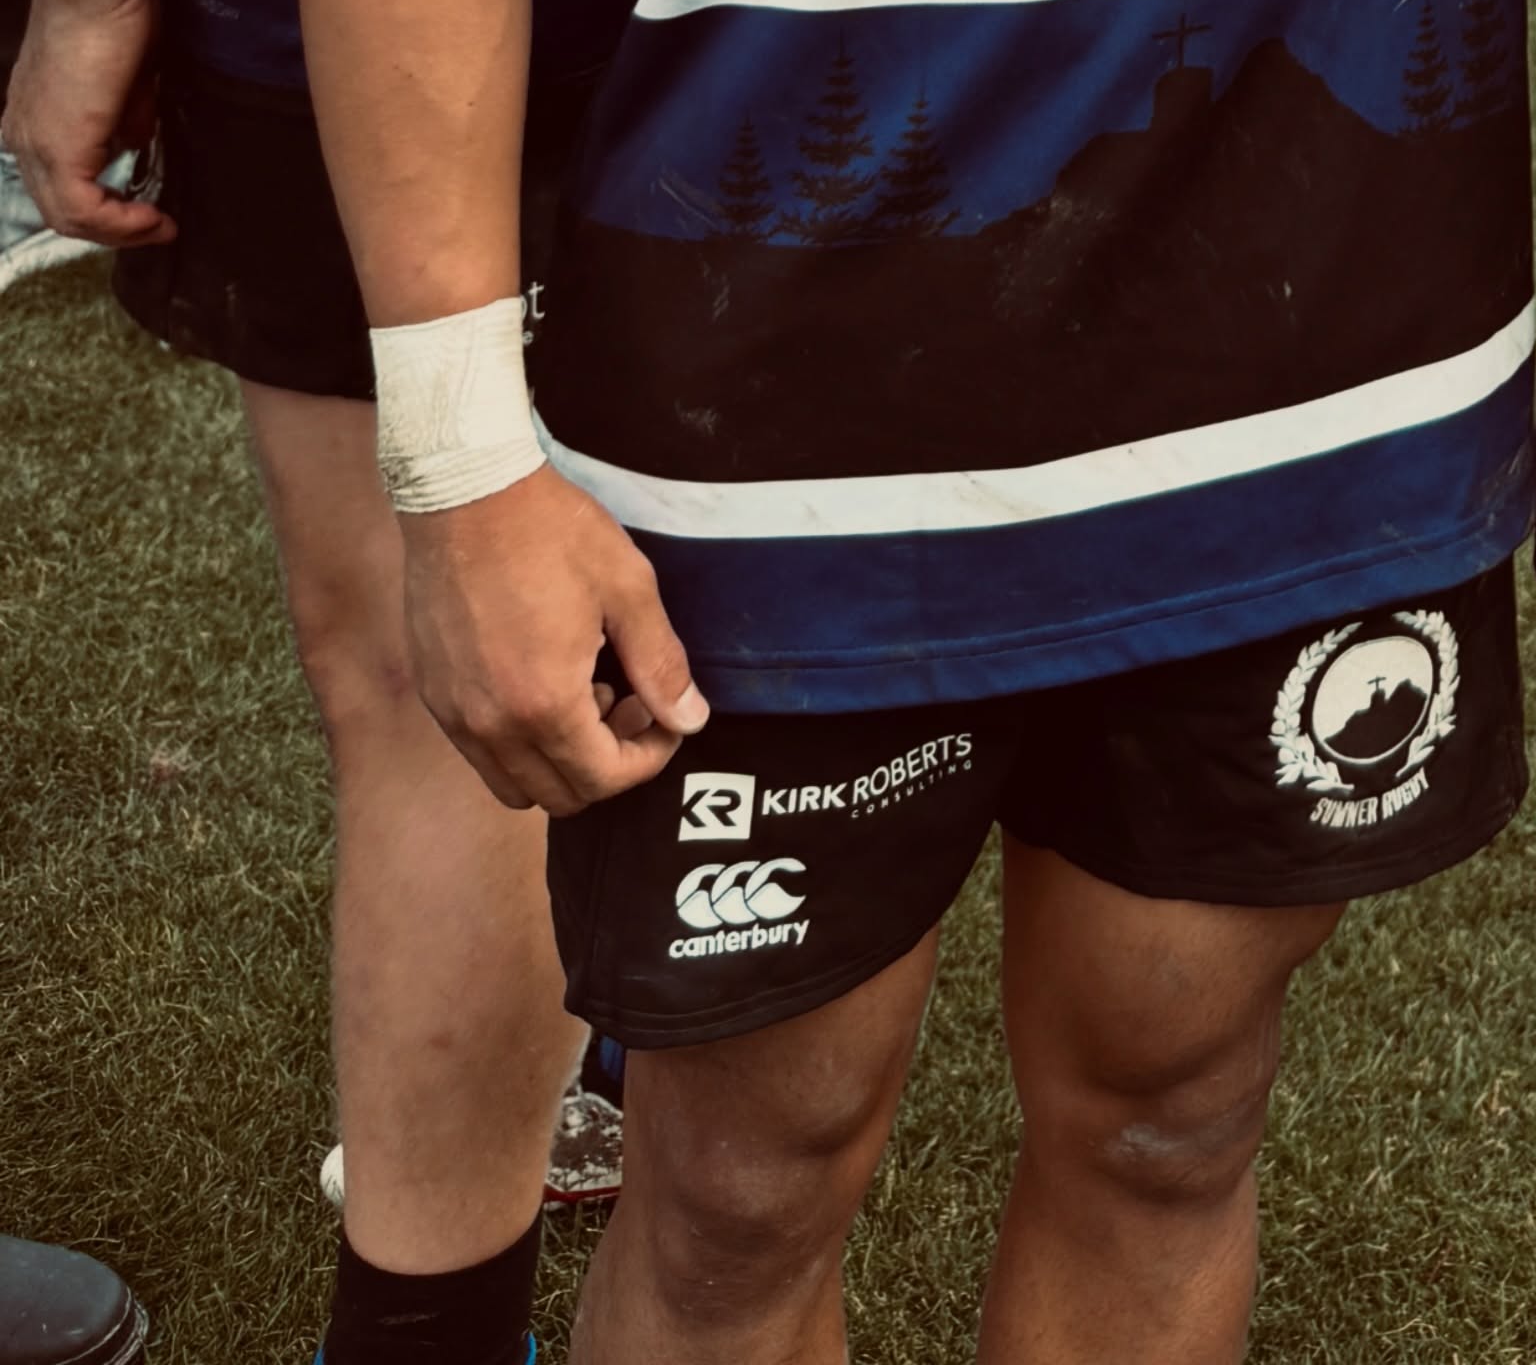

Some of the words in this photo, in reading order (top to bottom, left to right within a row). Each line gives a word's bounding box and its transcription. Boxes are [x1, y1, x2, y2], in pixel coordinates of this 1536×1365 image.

[761, 781, 848, 816] KIRK
[851, 732, 973, 806] ROBERTS
[850, 758, 973, 820] CONSULTING
[1309, 797, 1379, 828] SUMNER
[1382, 766, 1430, 820] RUGBY
[668, 919, 811, 959] canterbury
